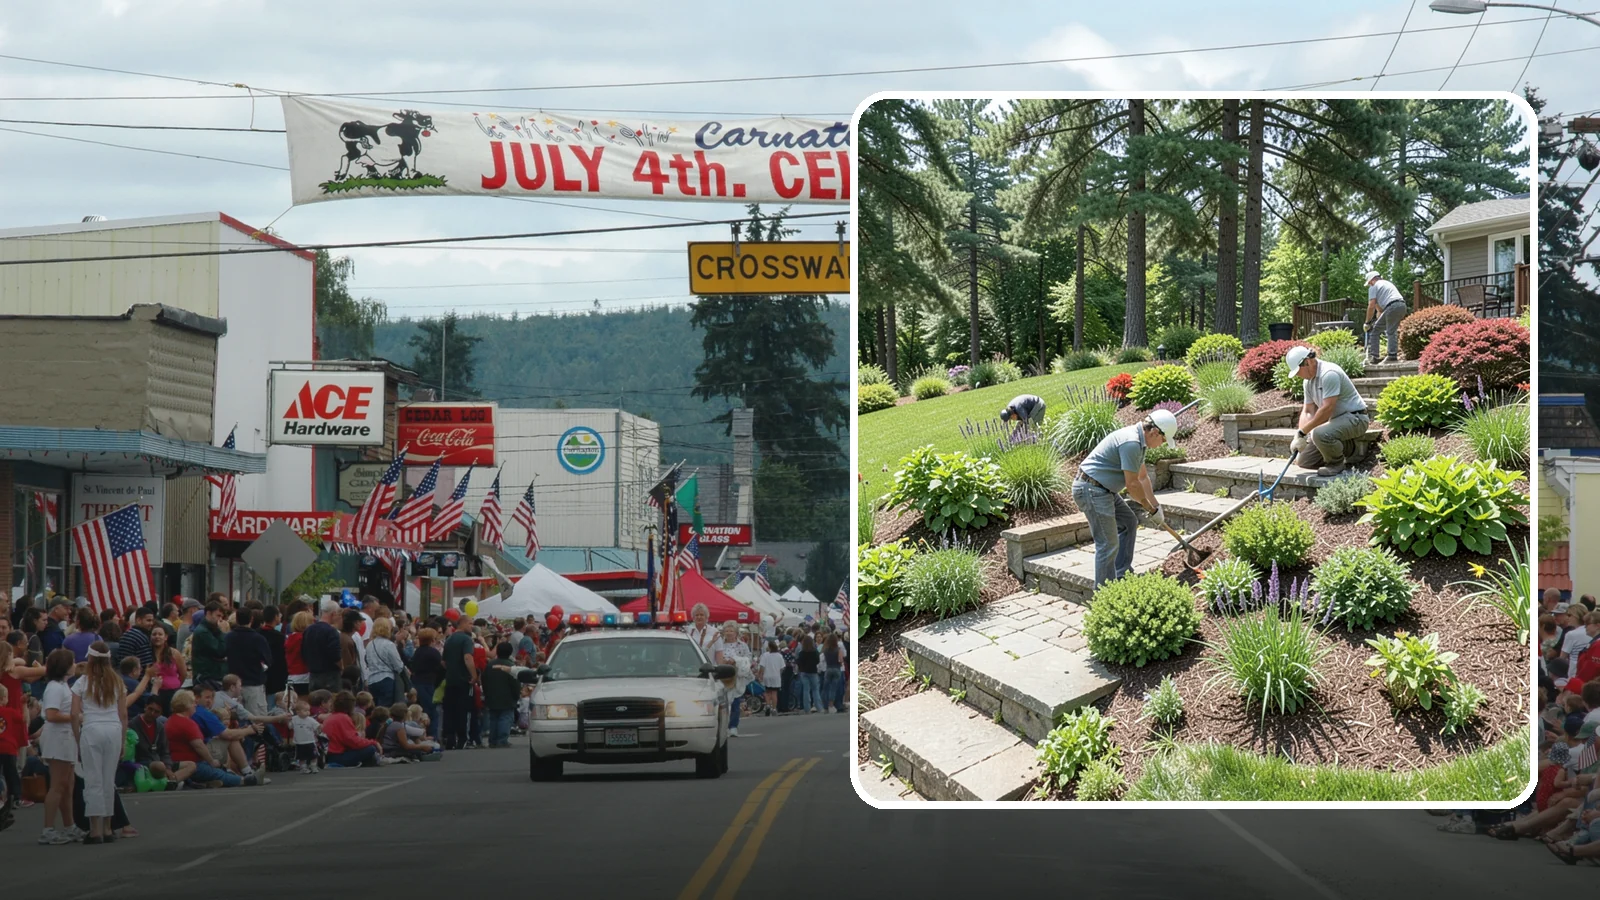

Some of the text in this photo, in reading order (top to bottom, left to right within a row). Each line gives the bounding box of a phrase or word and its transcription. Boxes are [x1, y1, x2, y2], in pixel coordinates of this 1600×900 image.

[481, 141, 604, 192] JULY
[632, 150, 746, 197] 4th.
[697, 254, 850, 279] CROSSWA
[283, 380, 373, 420] ACE
[406, 409, 452, 422] CEDAR
[283, 421, 370, 436] Hardware
[416, 428, 477, 447] Coca-Cola
[353, 467, 386, 480] Simpl
[83, 485, 155, 495] St. Vincent de Paul
[212, 516, 330, 535] HARDARE
[688, 526, 741, 535] CRNATION
[699, 535, 730, 543] GLASS
